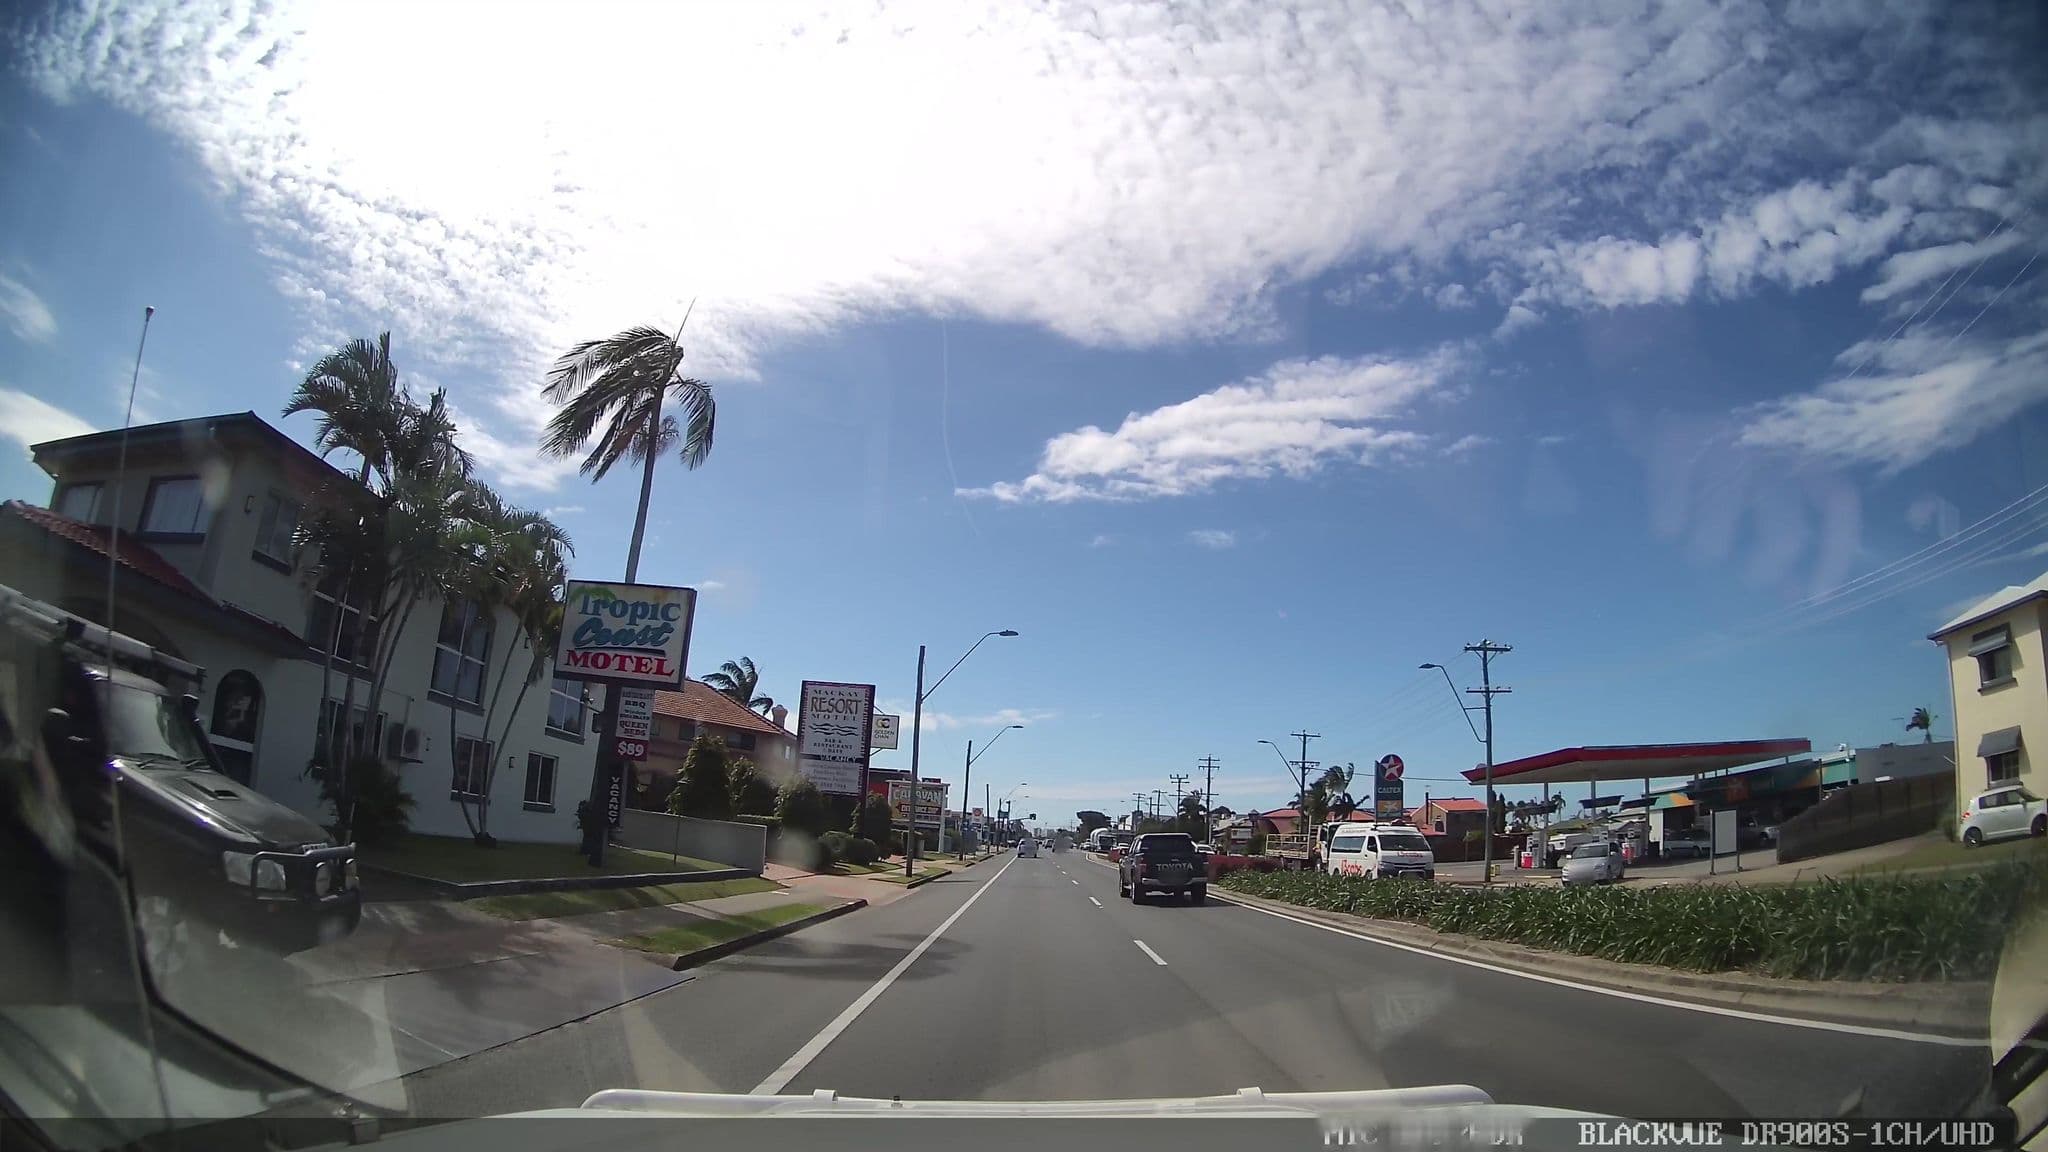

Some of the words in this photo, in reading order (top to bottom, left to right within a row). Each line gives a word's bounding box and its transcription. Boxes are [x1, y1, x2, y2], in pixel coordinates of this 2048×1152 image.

[578, 593, 681, 626] Tropic
[572, 617, 675, 647] Coast
[564, 649, 675, 677] MOTEL
[813, 689, 859, 697] MACKAY
[624, 700, 646, 709] BBQ
[810, 696, 862, 715] RESORT
[811, 713, 857, 721] MOTEL
[619, 720, 649, 730] QUEEN
[617, 741, 645, 757] $89
[608, 776, 620, 823] VACANCY
[893, 789, 940, 803] CAAVAN
[1156, 862, 1193, 872] TOYOTA
